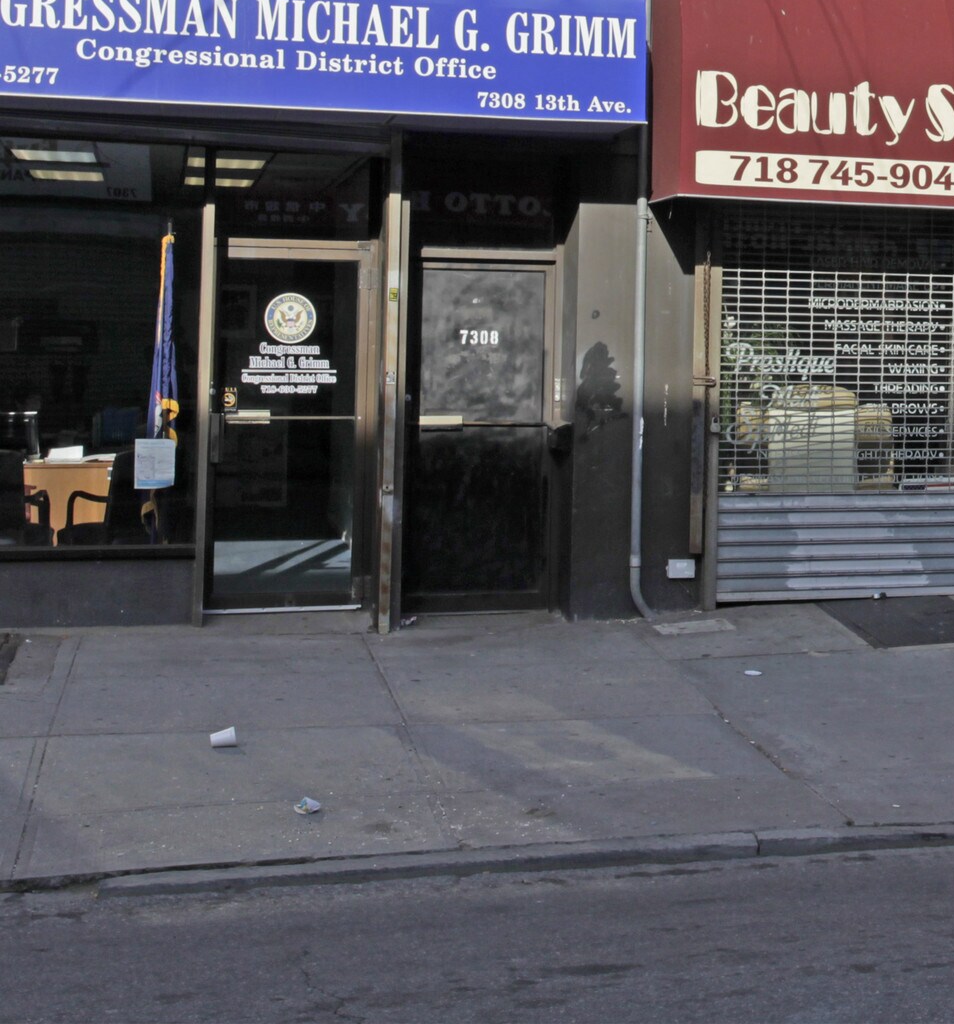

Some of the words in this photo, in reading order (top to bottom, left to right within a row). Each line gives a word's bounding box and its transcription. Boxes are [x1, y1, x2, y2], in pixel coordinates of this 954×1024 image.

[454, 8, 490, 52] G.
[506, 10, 637, 59] GRIMM
[76, 38, 286, 71] Congressional
[295, 49, 405, 77] District
[415, 55, 497, 81] Office
[477, 91, 526, 111] 7308
[535, 93, 581, 113] 13th
[588, 95, 633, 114] Ave.
[695, 69, 915, 146] Beauty
[729, 154, 799, 184] 718
[824, 318, 881, 332] MASSAGE
[883, 320, 939, 334] THERAPY
[459, 329, 499, 345] 7308
[259, 342, 320, 355] Congressman
[834, 343, 876, 356] FACIAL
[878, 343, 906, 356] SKIN
[908, 344, 939, 356] CARE
[249, 356, 286, 369] Michael
[298, 357, 330, 369] Grimm
[887, 362, 939, 375] WAXING
[891, 403, 939, 415] BROWS
[886, 426, 939, 438] SERVICES
